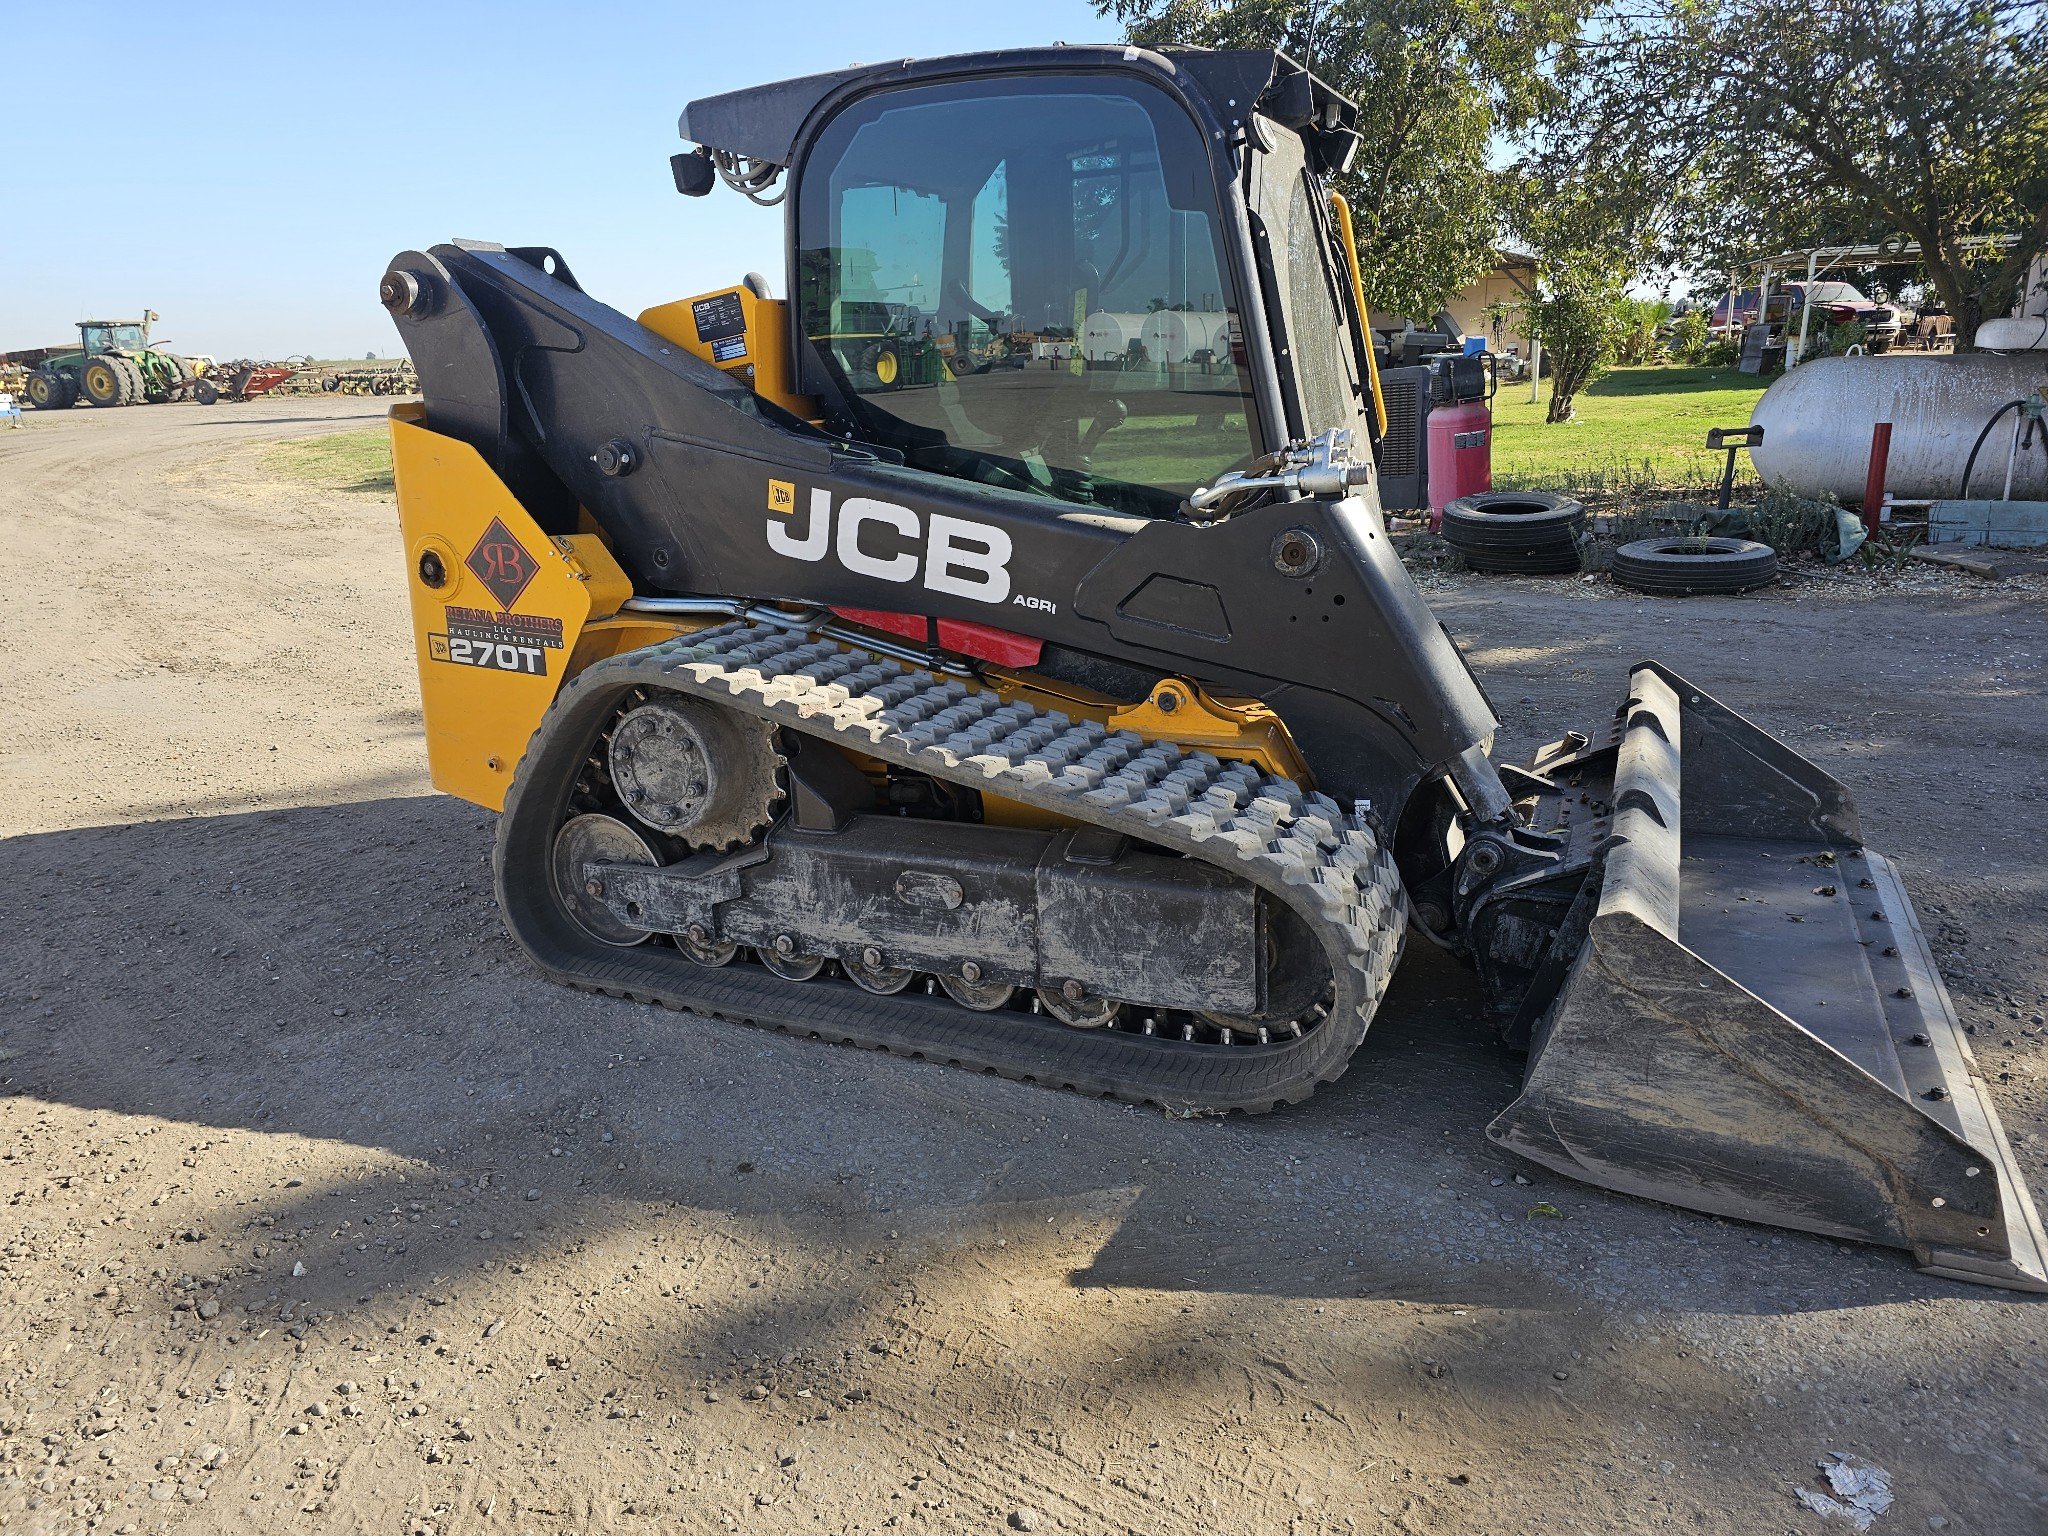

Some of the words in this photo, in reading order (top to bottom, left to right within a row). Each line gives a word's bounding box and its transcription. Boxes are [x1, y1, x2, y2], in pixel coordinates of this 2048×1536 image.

[774, 487, 790, 503] JCB
[766, 487, 1013, 604] JCB
[1013, 594, 1057, 615] AGRI
[446, 607, 494, 623] RETANA
[497, 612, 563, 632] BROTHERS
[493, 625, 512, 634] LLC
[449, 627, 499, 640] HAULING
[513, 635, 563, 648] RENTALS
[450, 638, 541, 673] 270T
